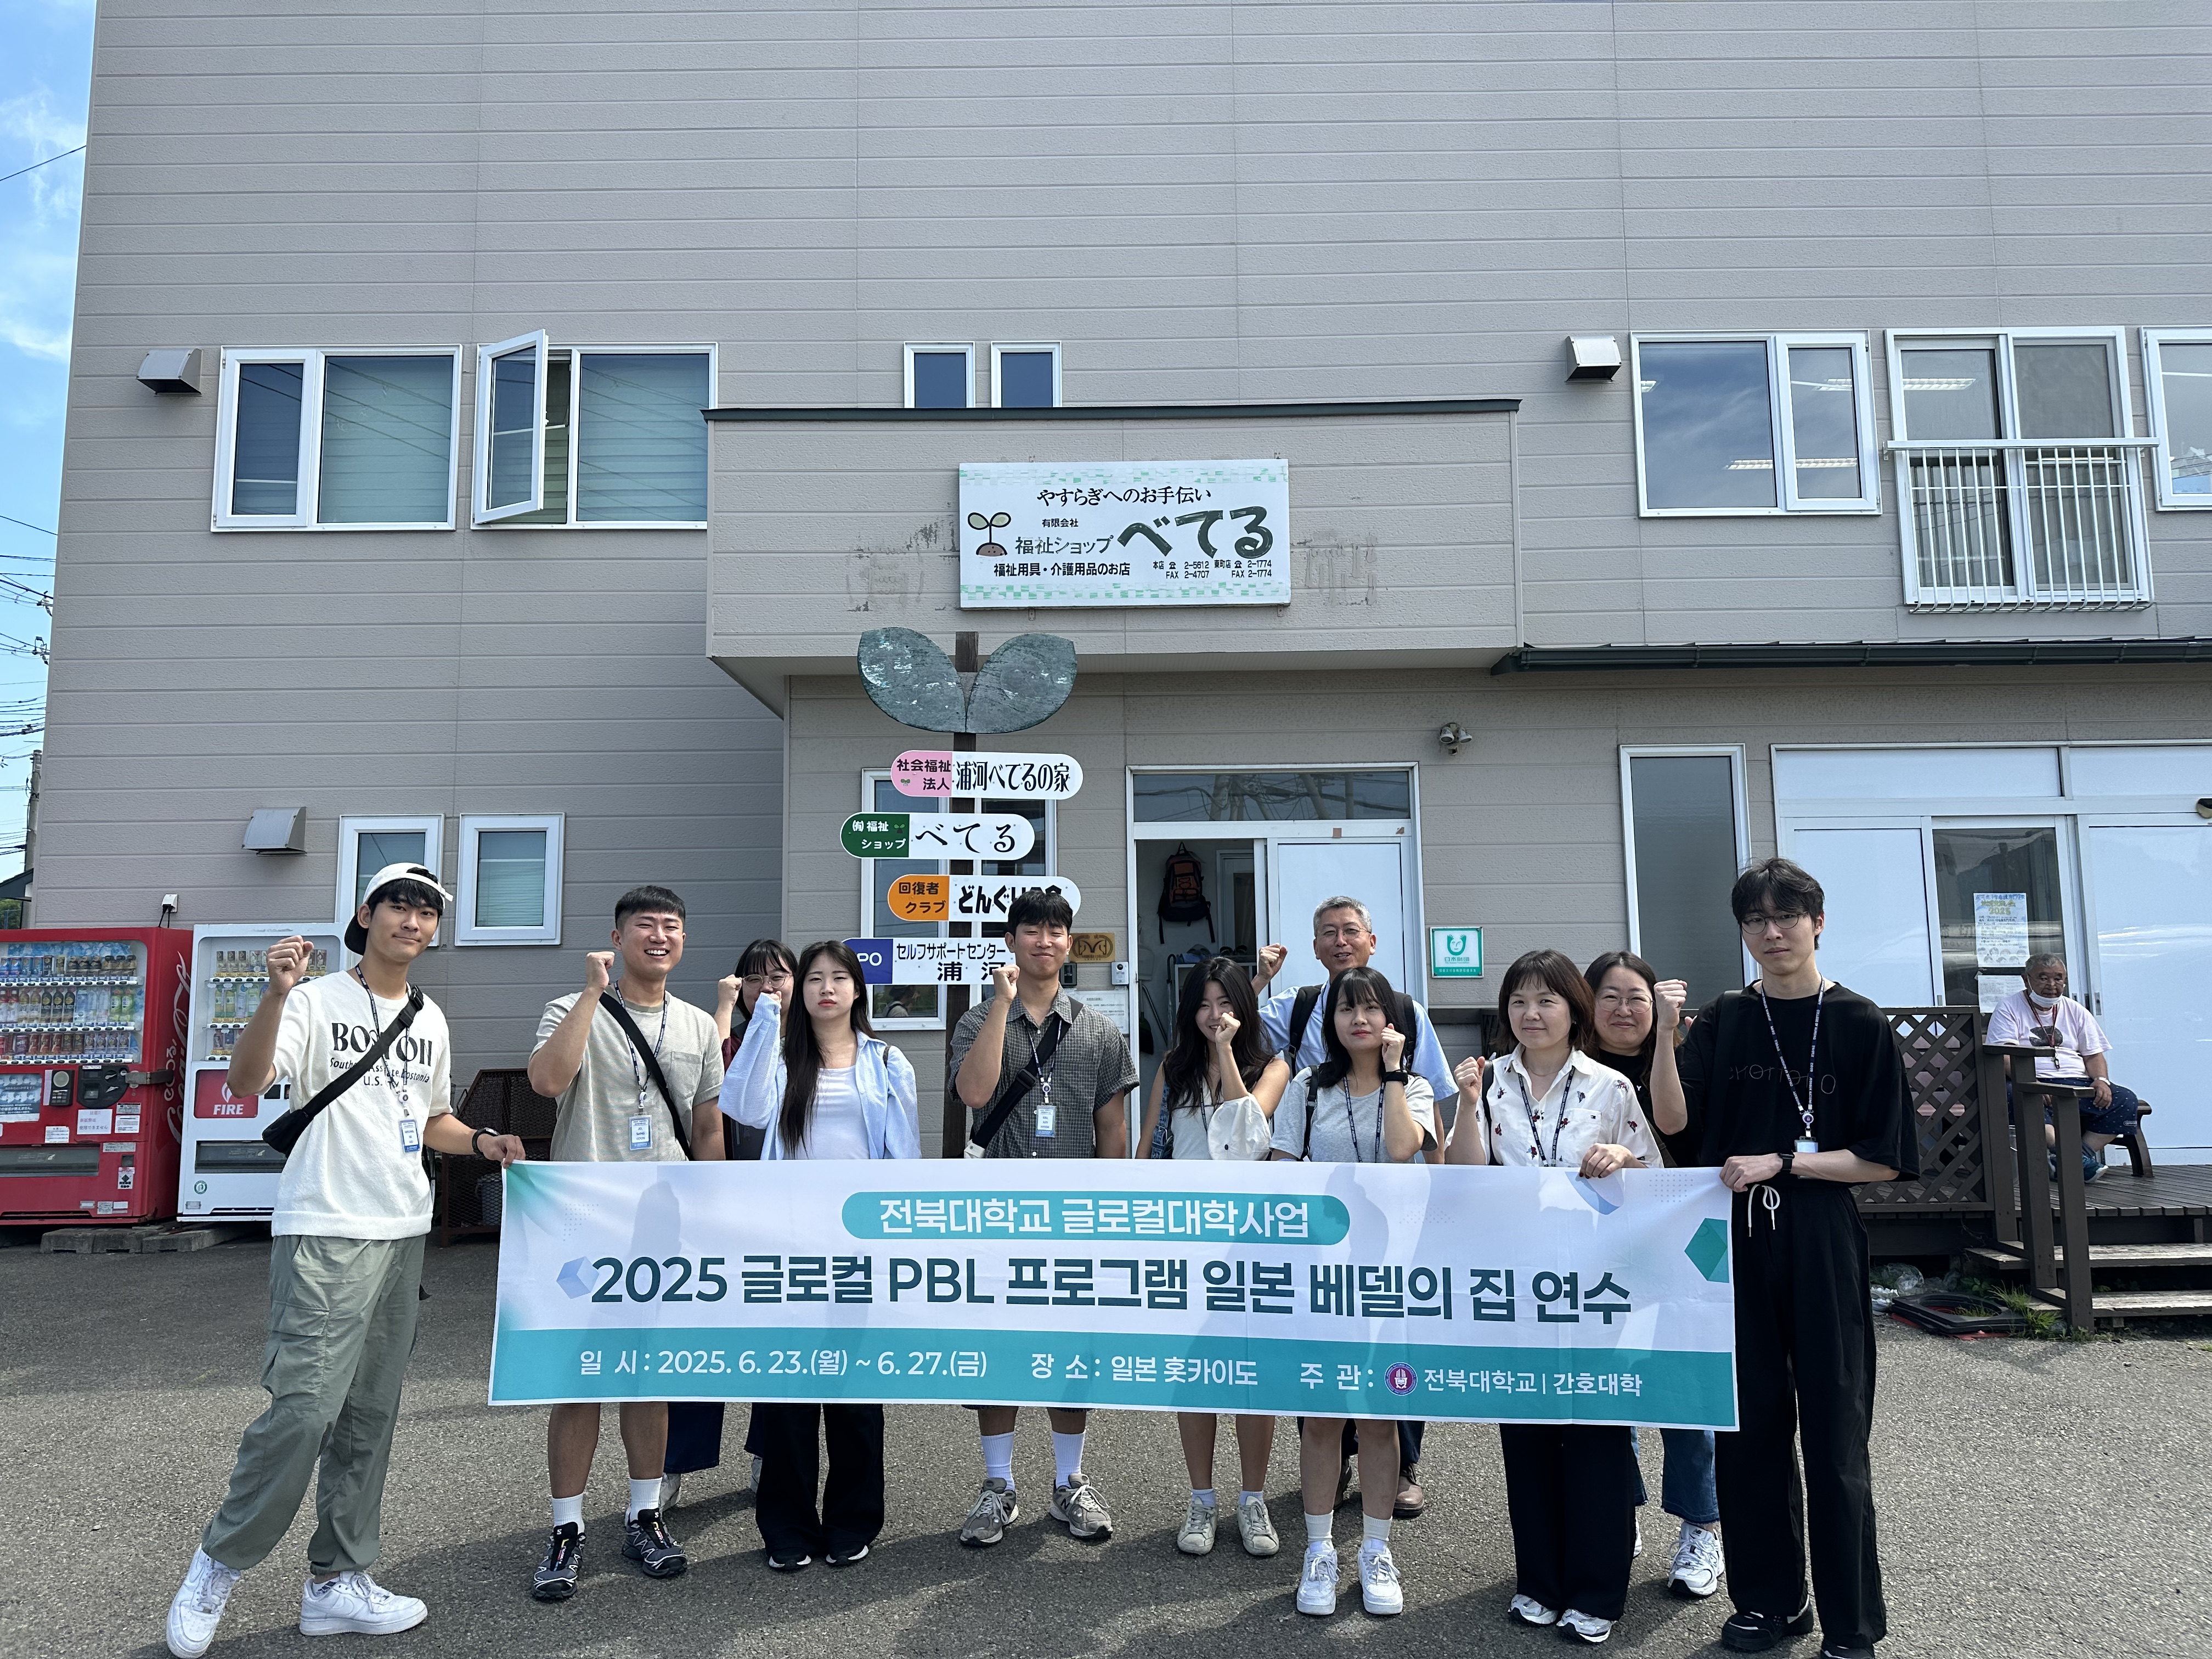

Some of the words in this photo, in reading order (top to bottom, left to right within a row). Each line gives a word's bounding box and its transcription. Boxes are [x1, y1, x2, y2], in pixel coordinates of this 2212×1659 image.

[1037, 486, 1211, 506] やすらぎへのお手伝い
[1042, 518, 1079, 528] 有限会社
[1015, 535, 1114, 555] 福祉ショップ
[1118, 506, 1273, 558] べてる
[994, 562, 1130, 577] 福祉用具・介護用品のお店
[1153, 561, 1164, 569] 本店
[1184, 561, 1209, 569] 2-5612
[1247, 560, 1272, 568] 2-1774
[896, 759, 951, 772] 社会福祉
[956, 760, 1070, 793] 浦河べてるの家
[923, 777, 950, 791] 法人
[866, 821, 889, 832] 福祉
[861, 838, 906, 850] ショップ
[915, 823, 1015, 853] べてる
[898, 882, 939, 895] 回復者
[905, 900, 946, 914] クラブ
[896, 942, 1006, 960] セルフサポートセンター
[213, 1104, 244, 1115] FIRE
[881, 1198, 1052, 1233] 전북대학교
[1062, 1199, 1308, 1238] 글로컬대학사업
[591, 1256, 727, 1303] 2025
[741, 1255, 873, 1304] 글로컬
[889, 1258, 995, 1304] PBL
[1006, 1258, 1188, 1310] 프로그램
[1203, 1260, 1295, 1314] 일본
[1310, 1264, 1453, 1320] 베델의
[1470, 1268, 1516, 1322] 집
[1532, 1271, 1631, 1325] 연수
[658, 1350, 731, 1374] 2025.
[738, 1350, 761, 1374] 6.
[768, 1349, 848, 1376] 23.(월)
[877, 1351, 901, 1375] 6.
[907, 1351, 987, 1378] 27.(금)
[1111, 1356, 1157, 1382] 일본
[1164, 1356, 1258, 1385] 홋카이도
[1424, 1369, 1537, 1394] 전북대학교
[1553, 1372, 1643, 1397] 간호대학
